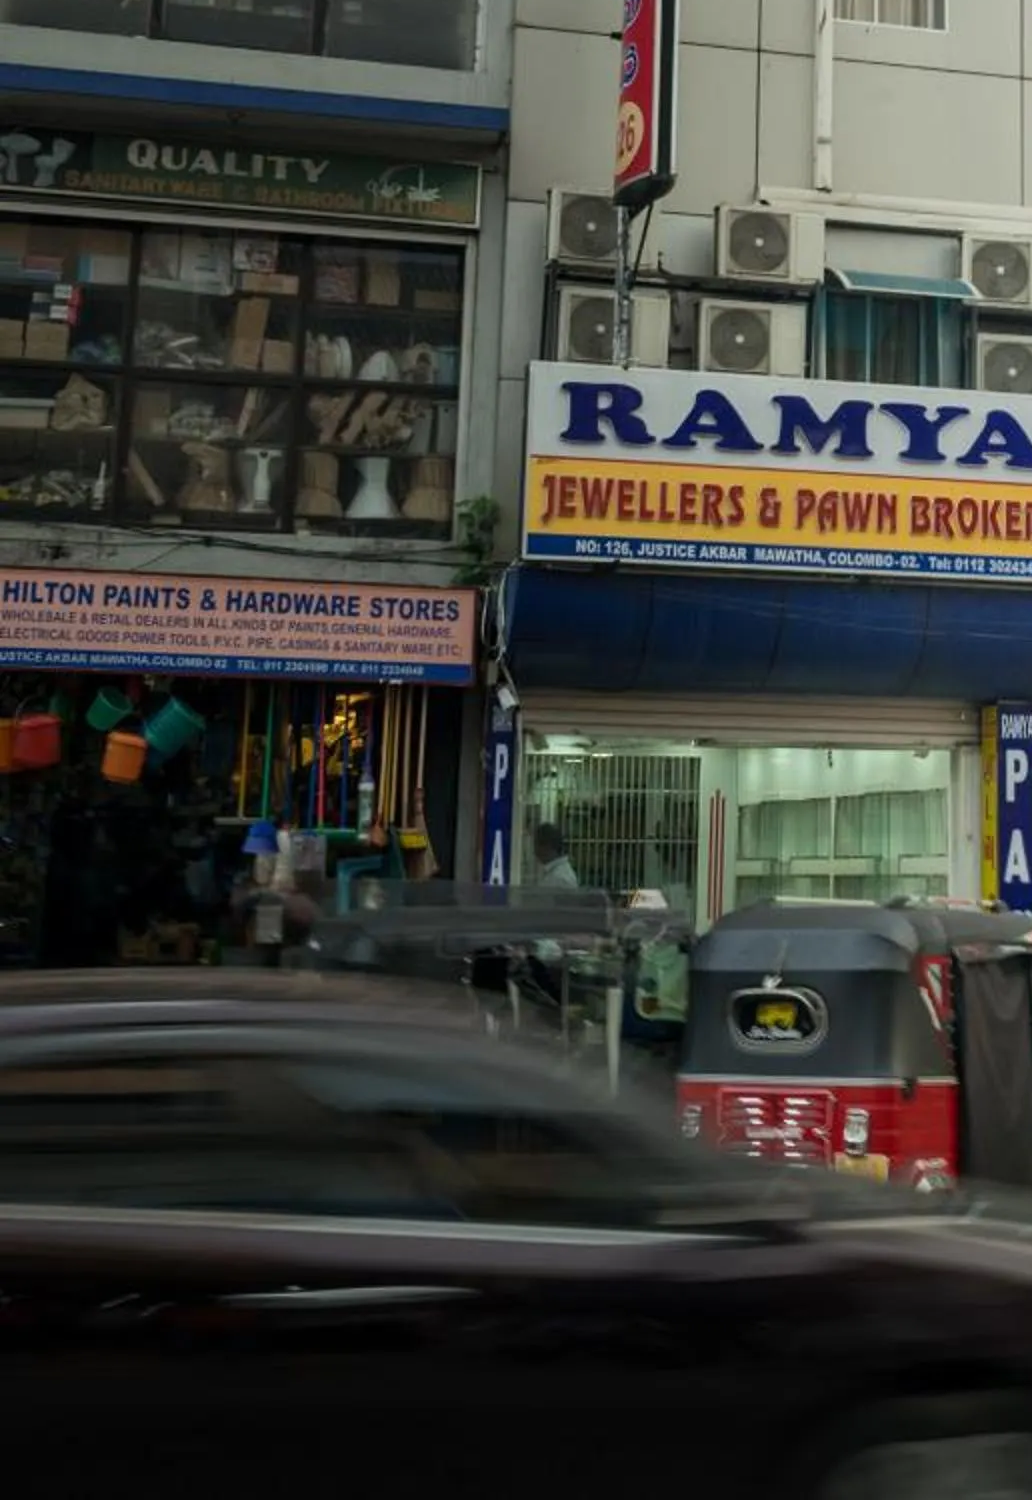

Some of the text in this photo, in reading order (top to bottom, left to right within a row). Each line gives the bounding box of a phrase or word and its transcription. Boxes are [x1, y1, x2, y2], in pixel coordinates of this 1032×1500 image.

[126, 138, 331, 184] QUALITY
[540, 473, 744, 528] JEWELLERS
[757, 493, 782, 528] &
[795, 487, 898, 535] PAWN
[575, 539, 601, 555] NO:
[605, 541, 634, 559] 126,
[636, 542, 697, 560] JUSTICE
[699, 545, 748, 561] AKBAR
[754, 547, 826, 566] MAWATHA,
[928, 555, 952, 571] Tel:
[954, 556, 985, 573] 0112
[3, 579, 460, 622] HILTON PAINTS & HARDWARE STORES
[1, 609, 77, 625] WHOLESALE
[91, 612, 131, 627] RETAIL
[135, 613, 191, 629] DEALERS
[193, 616, 206, 629] IN
[207, 615, 228, 631] ALL
[231, 618, 267, 631] KINDS
[269, 619, 285, 631] OF
[0, 625, 74, 642] ELECTRICAL
[78, 630, 120, 643] GOODS
[122, 631, 167, 645] POWER
[343, 640, 399, 654] SANITARY
[401, 643, 433, 656] WARE
[0, 651, 42, 663] USTICE
